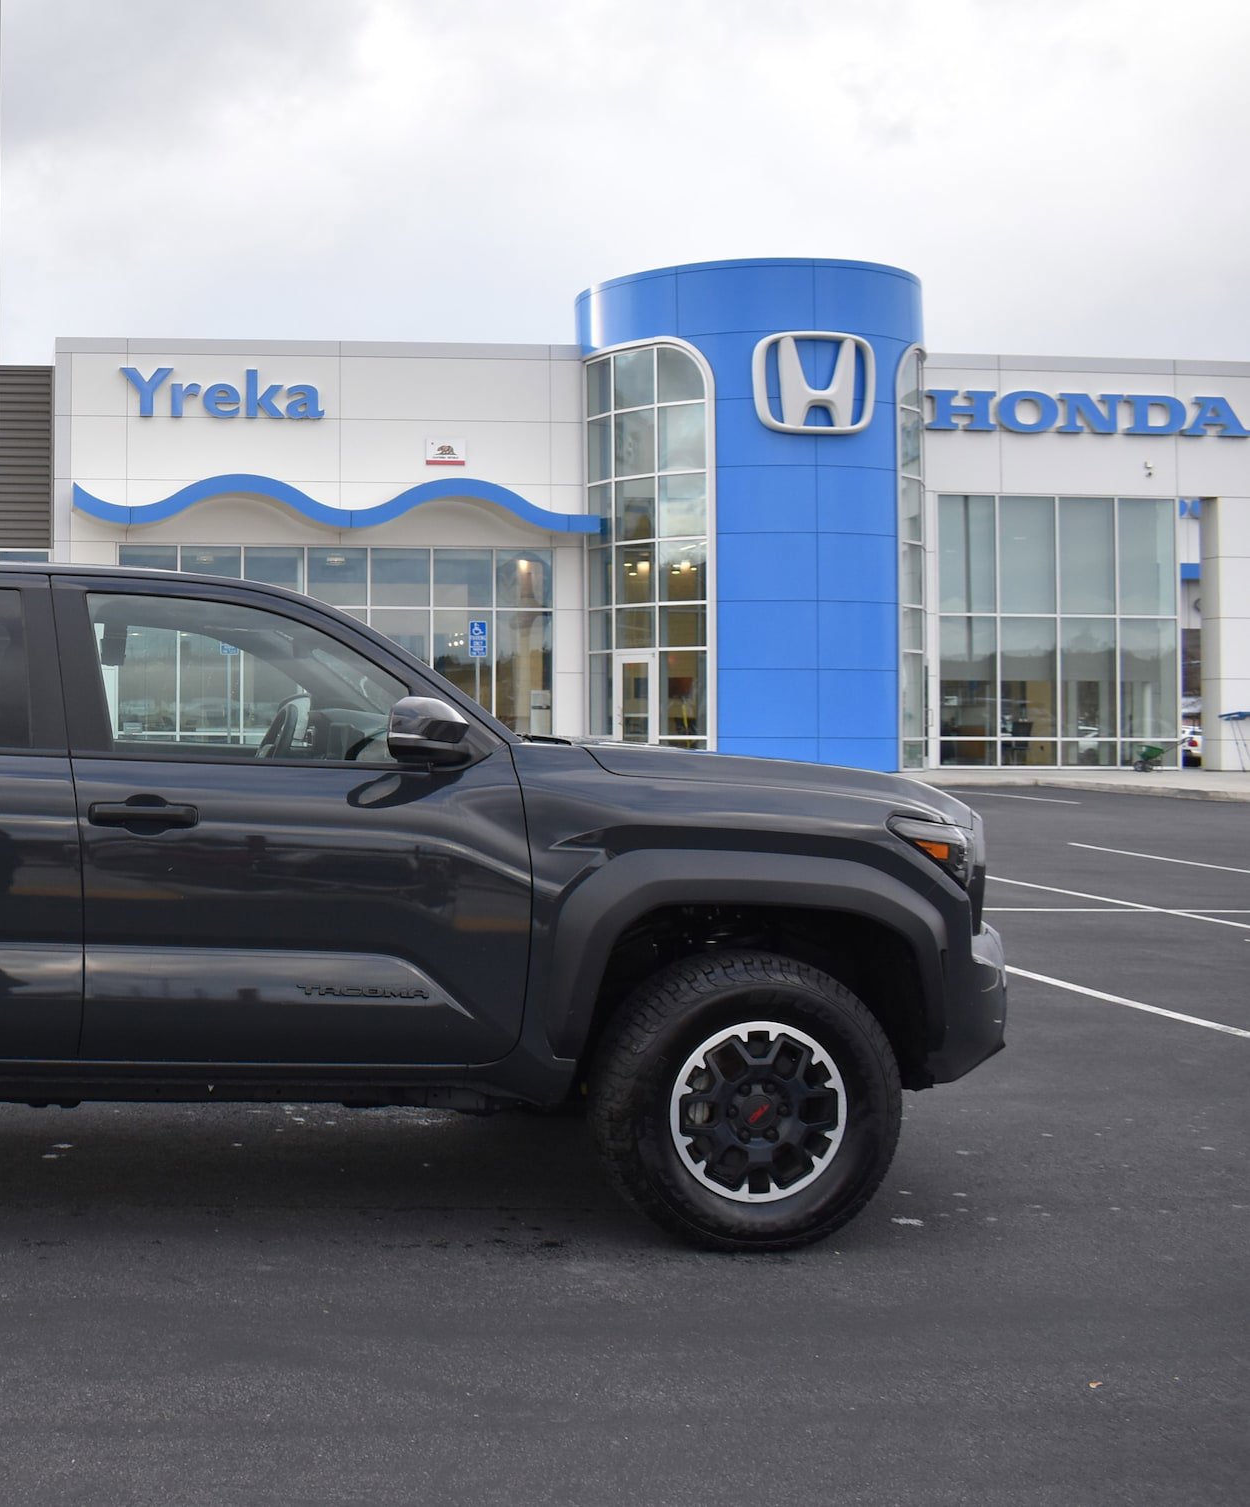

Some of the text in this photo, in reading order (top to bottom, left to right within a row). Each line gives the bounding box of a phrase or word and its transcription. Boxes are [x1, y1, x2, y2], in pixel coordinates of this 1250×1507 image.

[119, 366, 326, 420] Yreka
[924, 388, 1250, 437] HONDA
[296, 984, 430, 999] TACOMA
